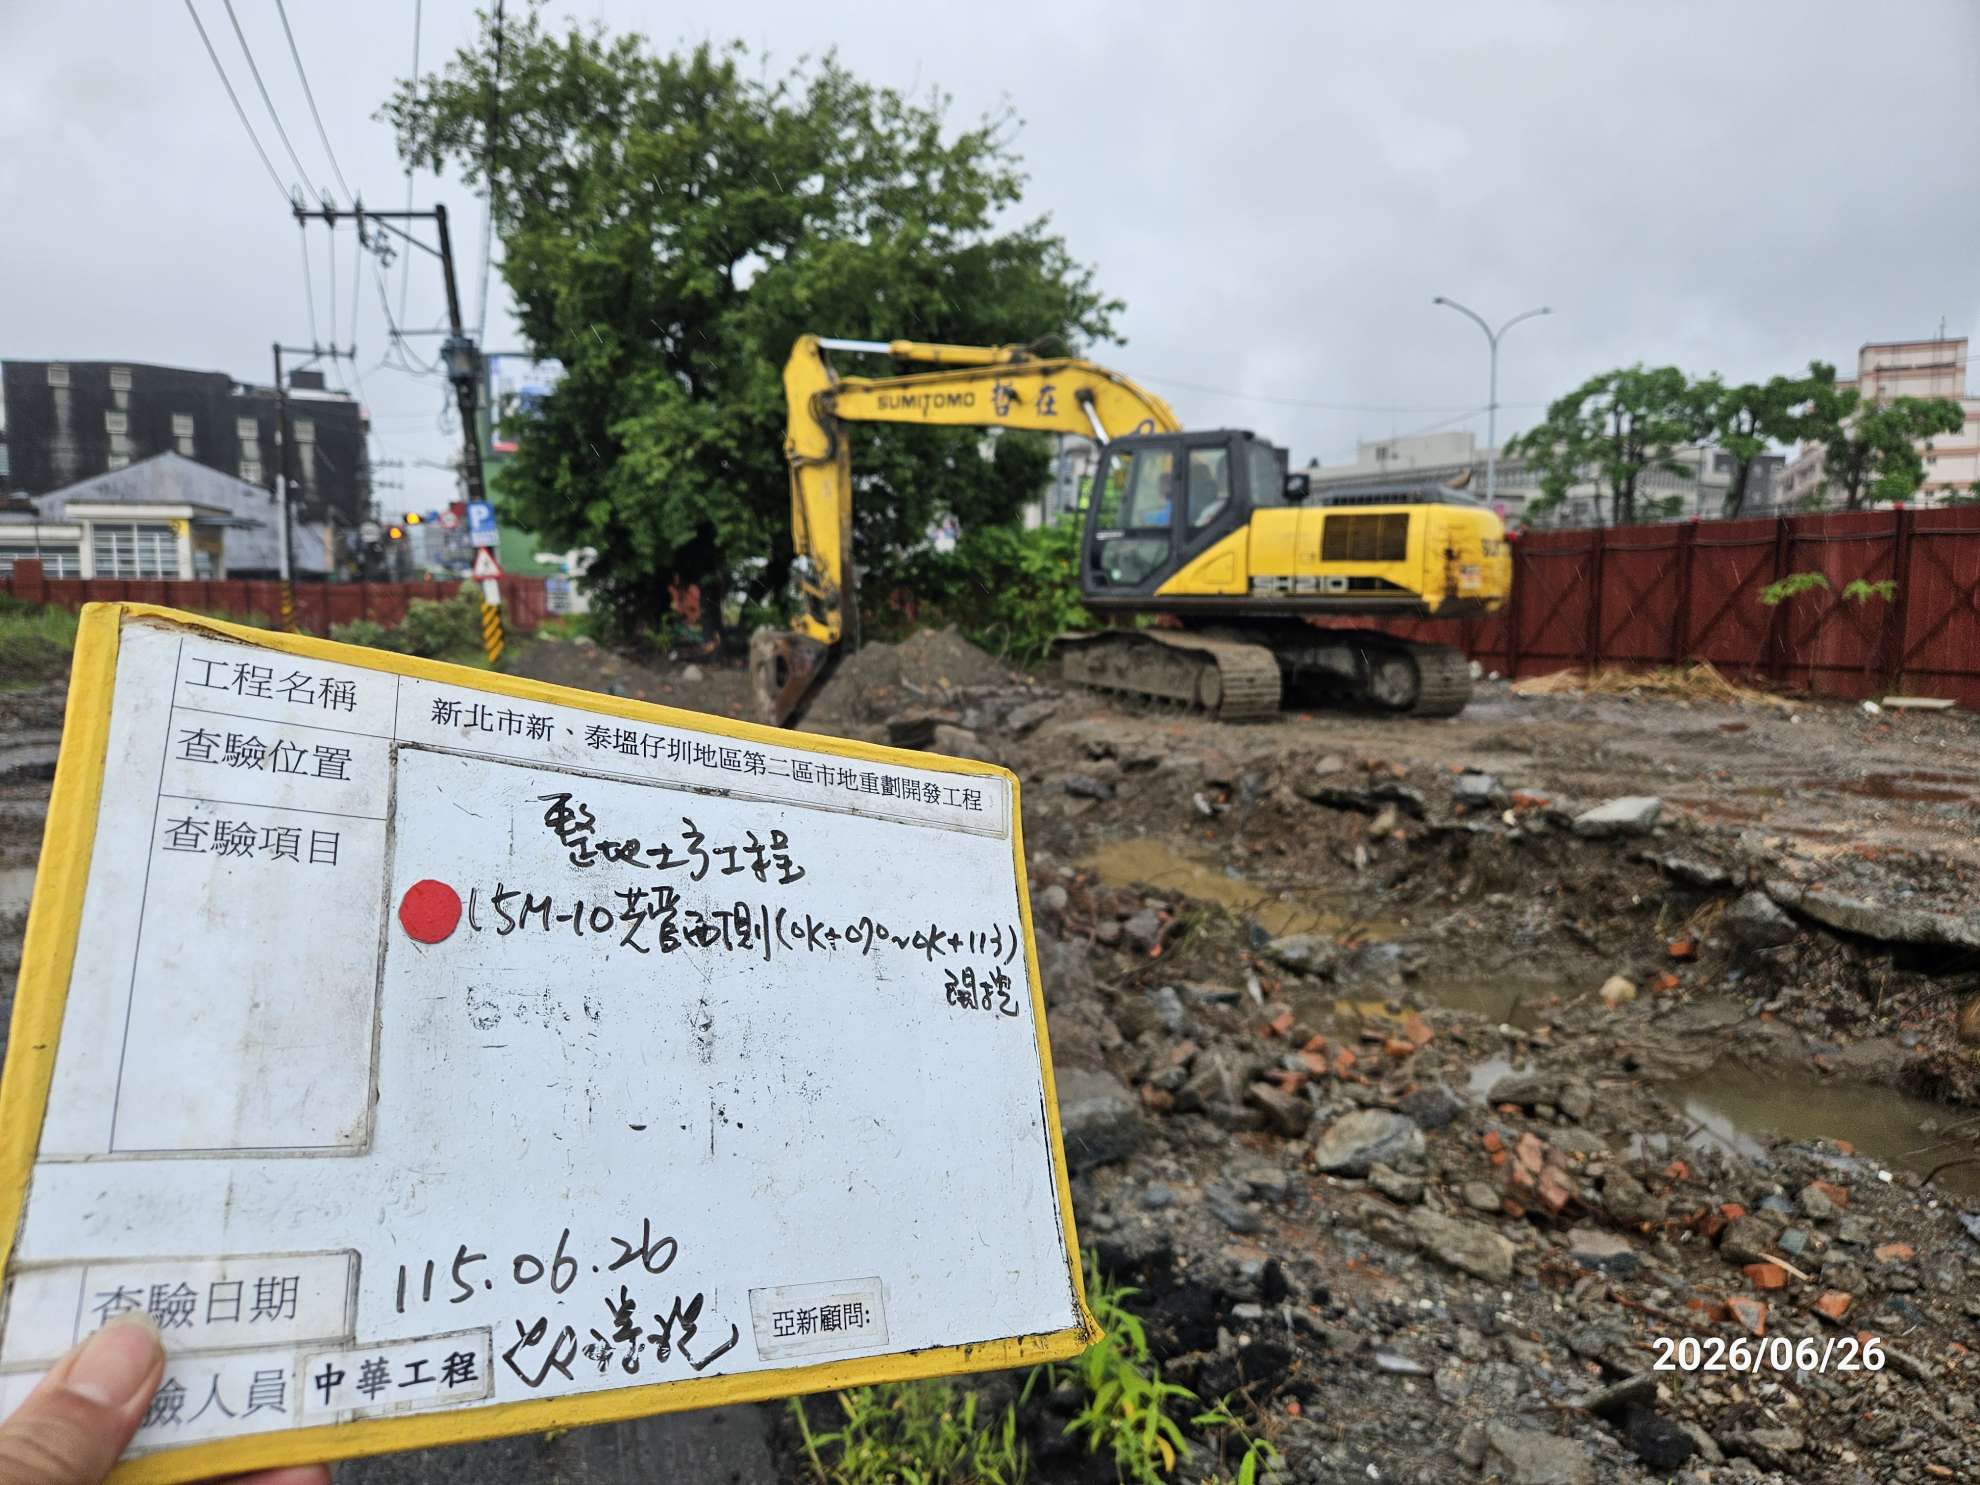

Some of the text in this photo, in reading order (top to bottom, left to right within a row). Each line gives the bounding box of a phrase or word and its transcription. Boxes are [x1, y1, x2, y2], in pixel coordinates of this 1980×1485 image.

[878, 392, 976, 411] SUMITOMO
[185, 656, 358, 713] 工程名稱
[175, 727, 352, 782] 查驗位置
[162, 816, 341, 867] 查驗項目
[395, 1218, 679, 1314] 115.06.26
[772, 1302, 871, 1338] 亞新顧問:
[313, 1350, 480, 1407] 中華工程
